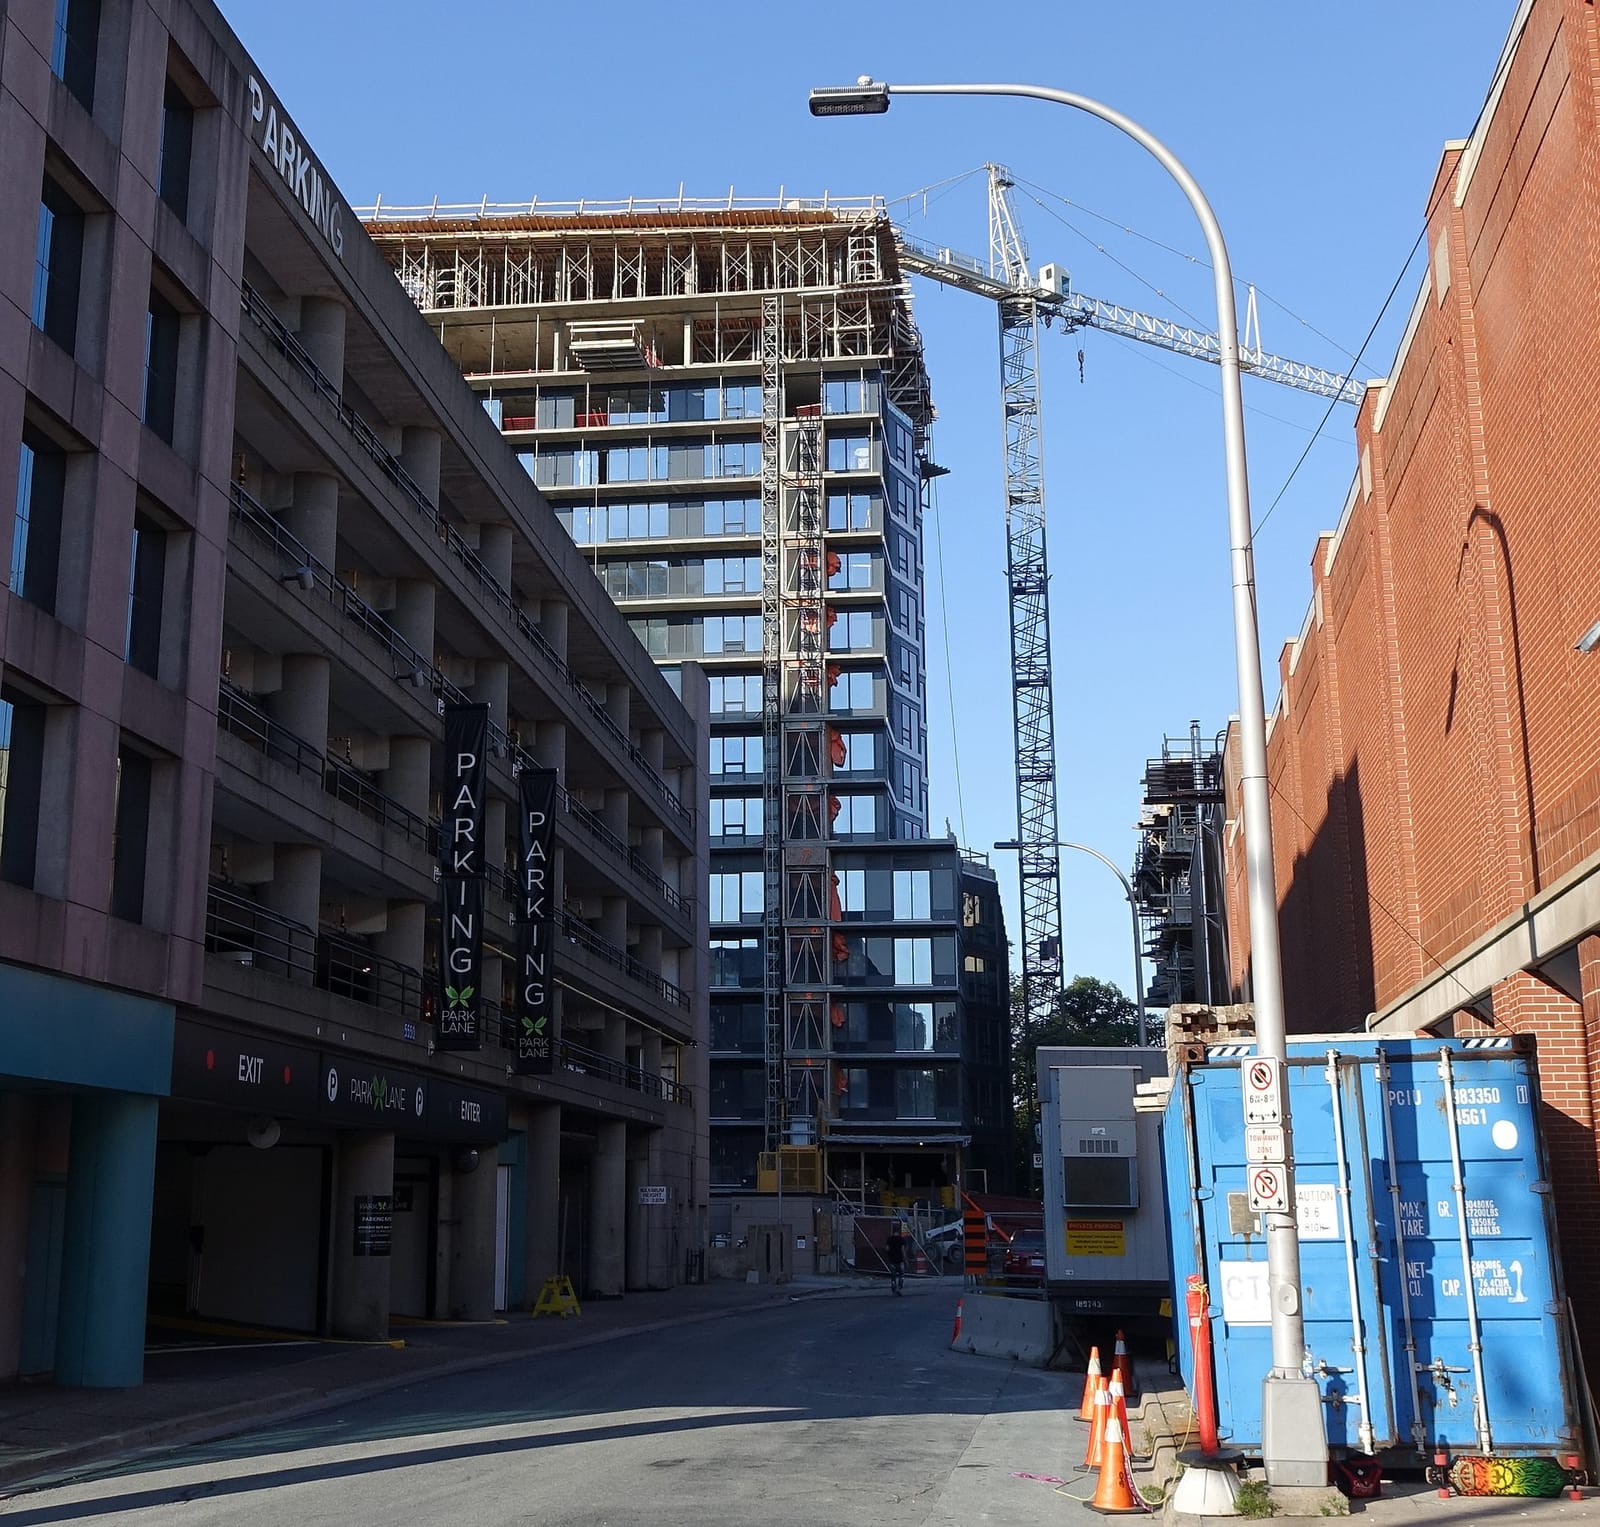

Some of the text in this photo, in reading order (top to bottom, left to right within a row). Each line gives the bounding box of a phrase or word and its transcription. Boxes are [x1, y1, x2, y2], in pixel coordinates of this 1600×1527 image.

[248, 74, 344, 260] PARKING
[449, 752, 477, 974] PARKING
[524, 811, 546, 1006] PARKING
[441, 1010, 476, 1022] PARK
[441, 1022, 476, 1034] LANE
[519, 1037, 549, 1048] PARK
[519, 1048, 549, 1059] LANE
[238, 1054, 264, 1085] EXIT
[350, 1077, 373, 1106] PARK
[384, 1083, 407, 1112] LANE
[1389, 1089, 1422, 1106] PCIU
[460, 1100, 481, 1123] ENTER
[1257, 1146, 1273, 1154] ZONE
[1297, 1191, 1333, 1202] AUTION
[1437, 1200, 1454, 1217] GR.
[1401, 1219, 1425, 1236] TARE
[1406, 1262, 1425, 1279] NET
[1227, 1275, 1269, 1301] CT
[1409, 1281, 1424, 1297] CU.
[1441, 1279, 1463, 1297] CAP.
